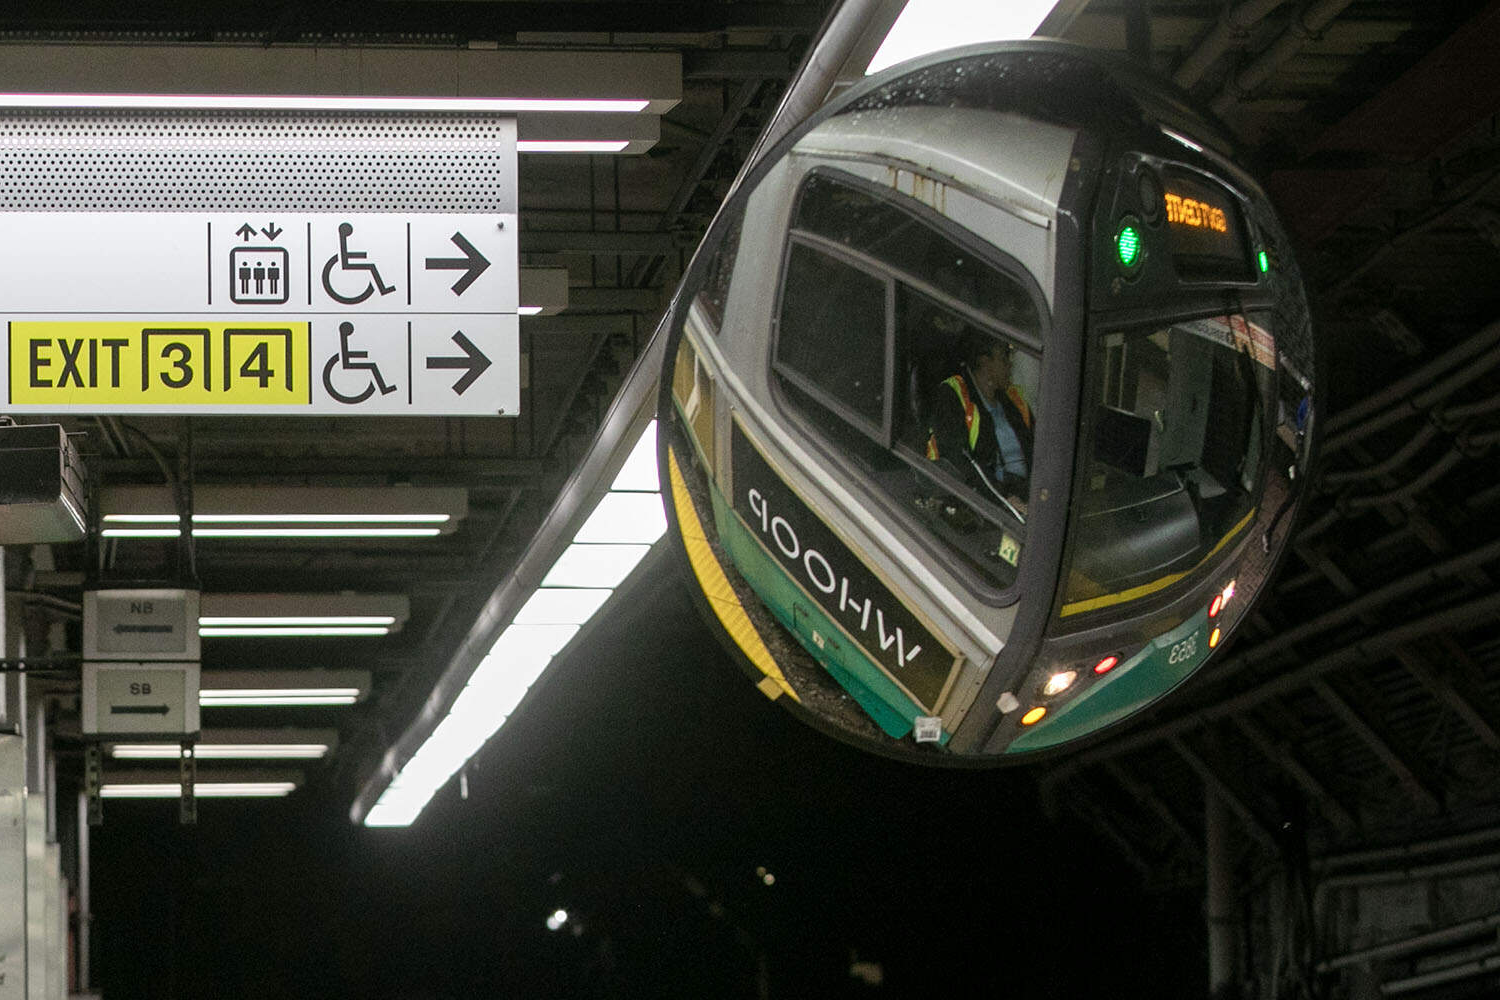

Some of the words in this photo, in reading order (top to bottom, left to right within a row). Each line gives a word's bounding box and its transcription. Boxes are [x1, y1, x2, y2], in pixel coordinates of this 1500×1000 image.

[29, 338, 130, 388] EXIT
[159, 342, 194, 389] 3
[239, 341, 275, 389] 4
[130, 603, 153, 615] NB
[129, 682, 152, 696] SB
